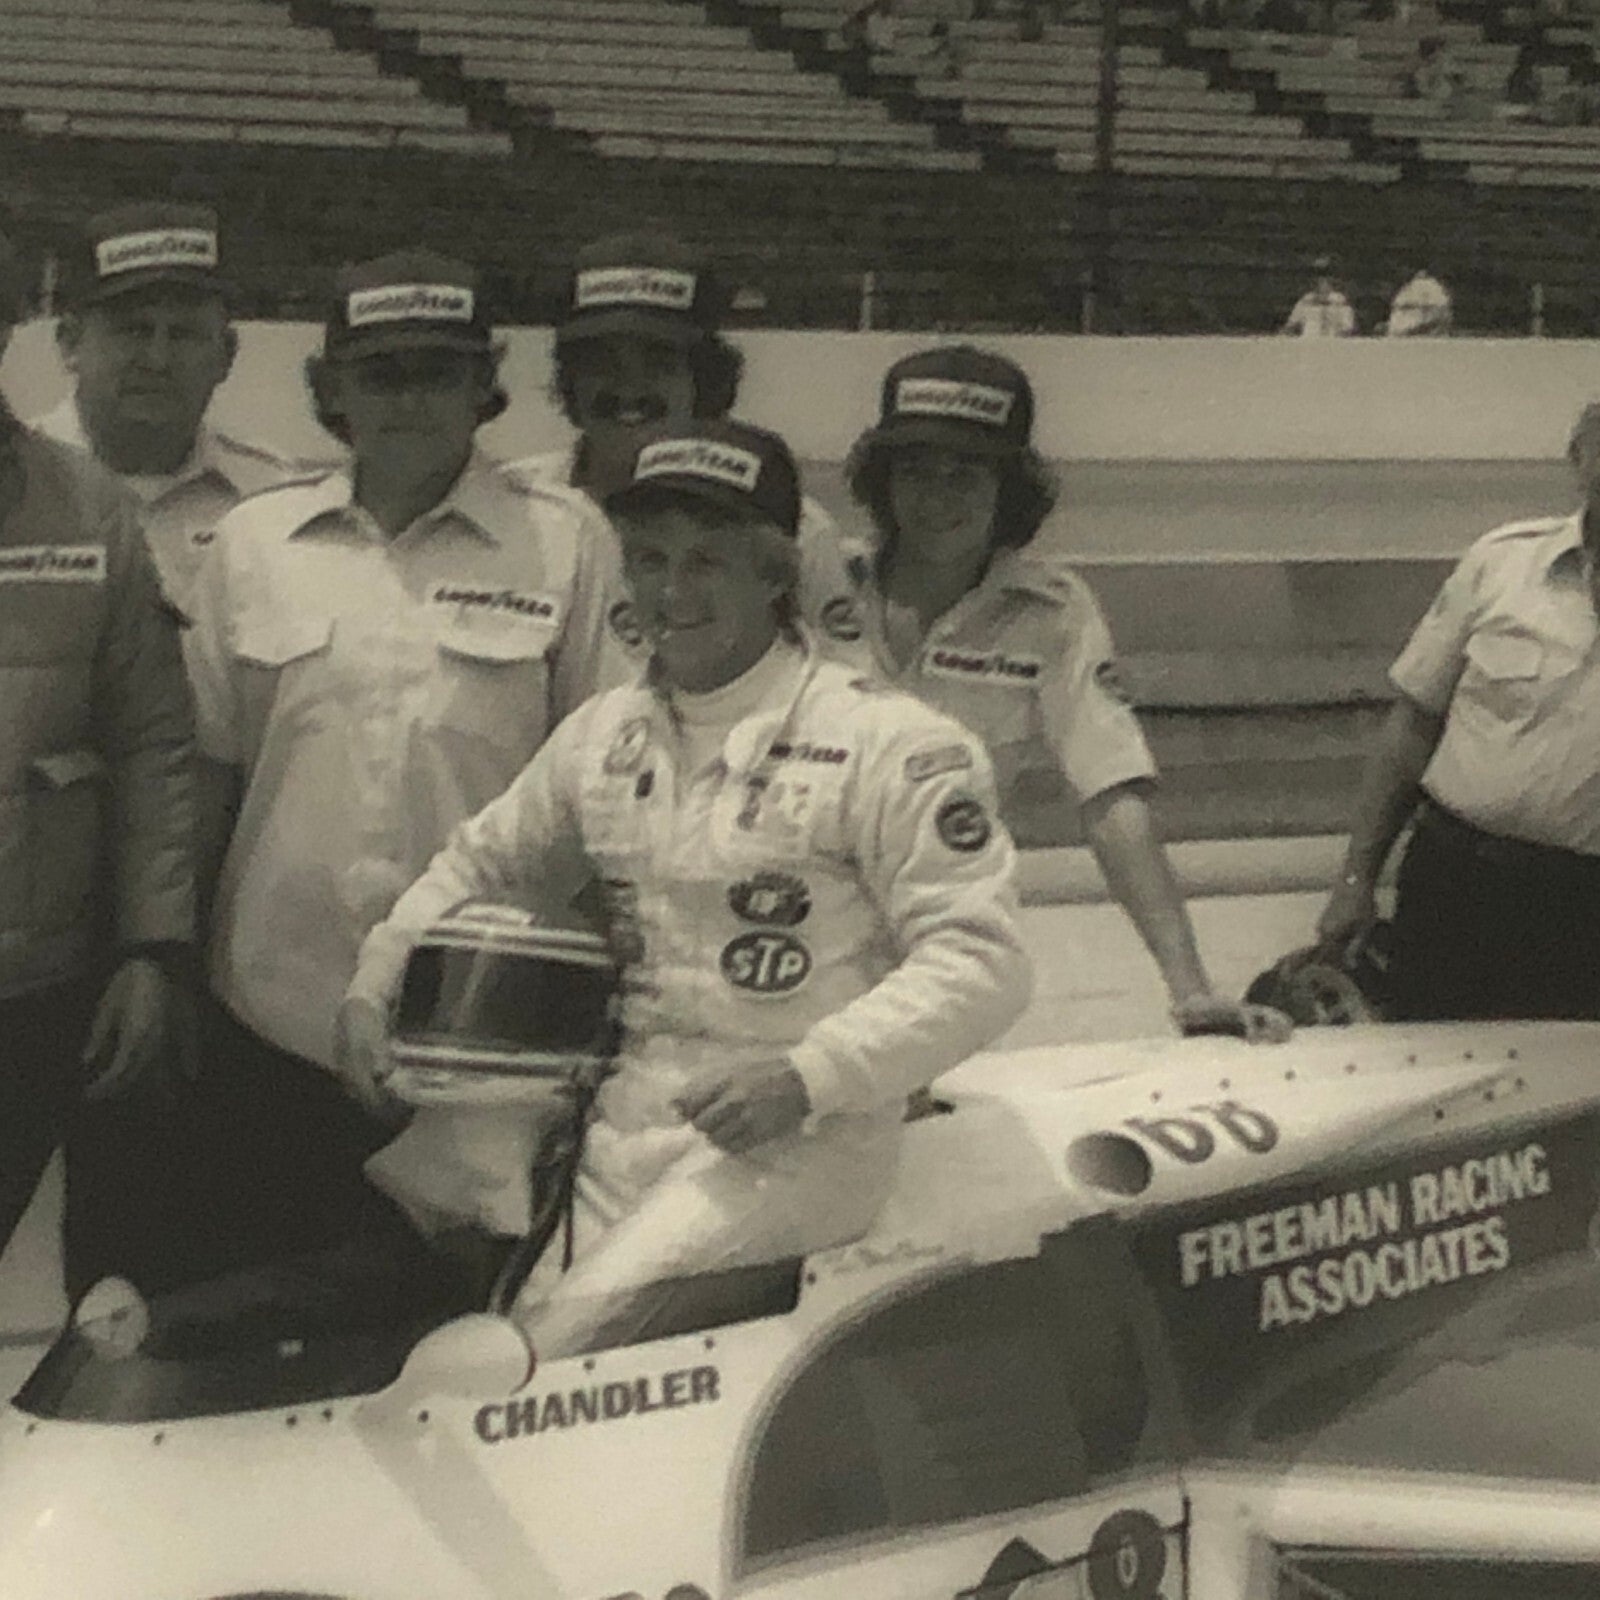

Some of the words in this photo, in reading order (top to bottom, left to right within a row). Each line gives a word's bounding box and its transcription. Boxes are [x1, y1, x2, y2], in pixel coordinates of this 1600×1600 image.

[731, 937, 804, 984] STP
[1178, 1185, 1399, 1288] FREEMAN
[1411, 1144, 1551, 1225] RACING
[1258, 1217, 1510, 1332] ASSOCIATES
[474, 1365, 721, 1443] CHANDLER
